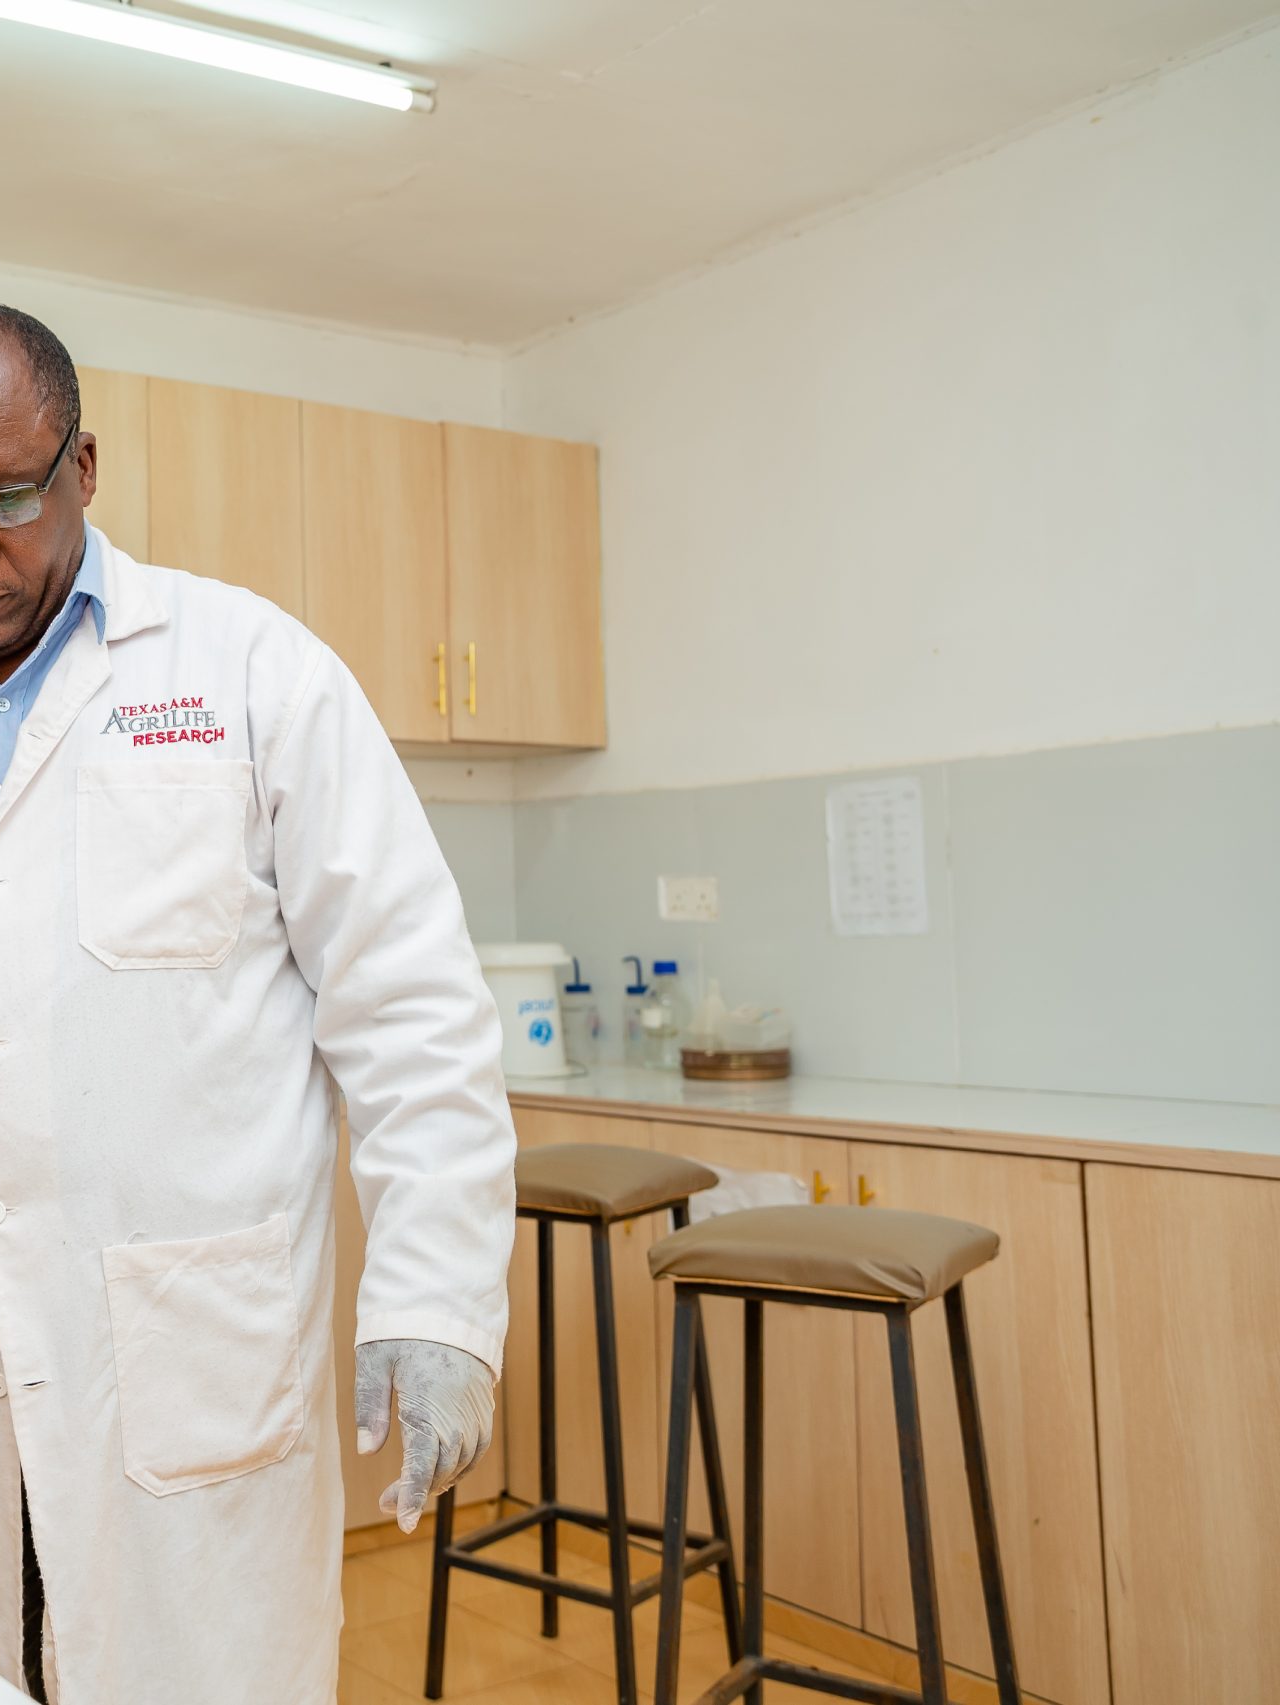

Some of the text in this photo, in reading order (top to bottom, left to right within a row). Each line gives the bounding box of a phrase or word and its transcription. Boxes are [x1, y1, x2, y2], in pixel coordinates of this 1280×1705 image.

[119, 697, 203, 716] TEXAS A&M
[133, 727, 225, 747] RESEARCH
